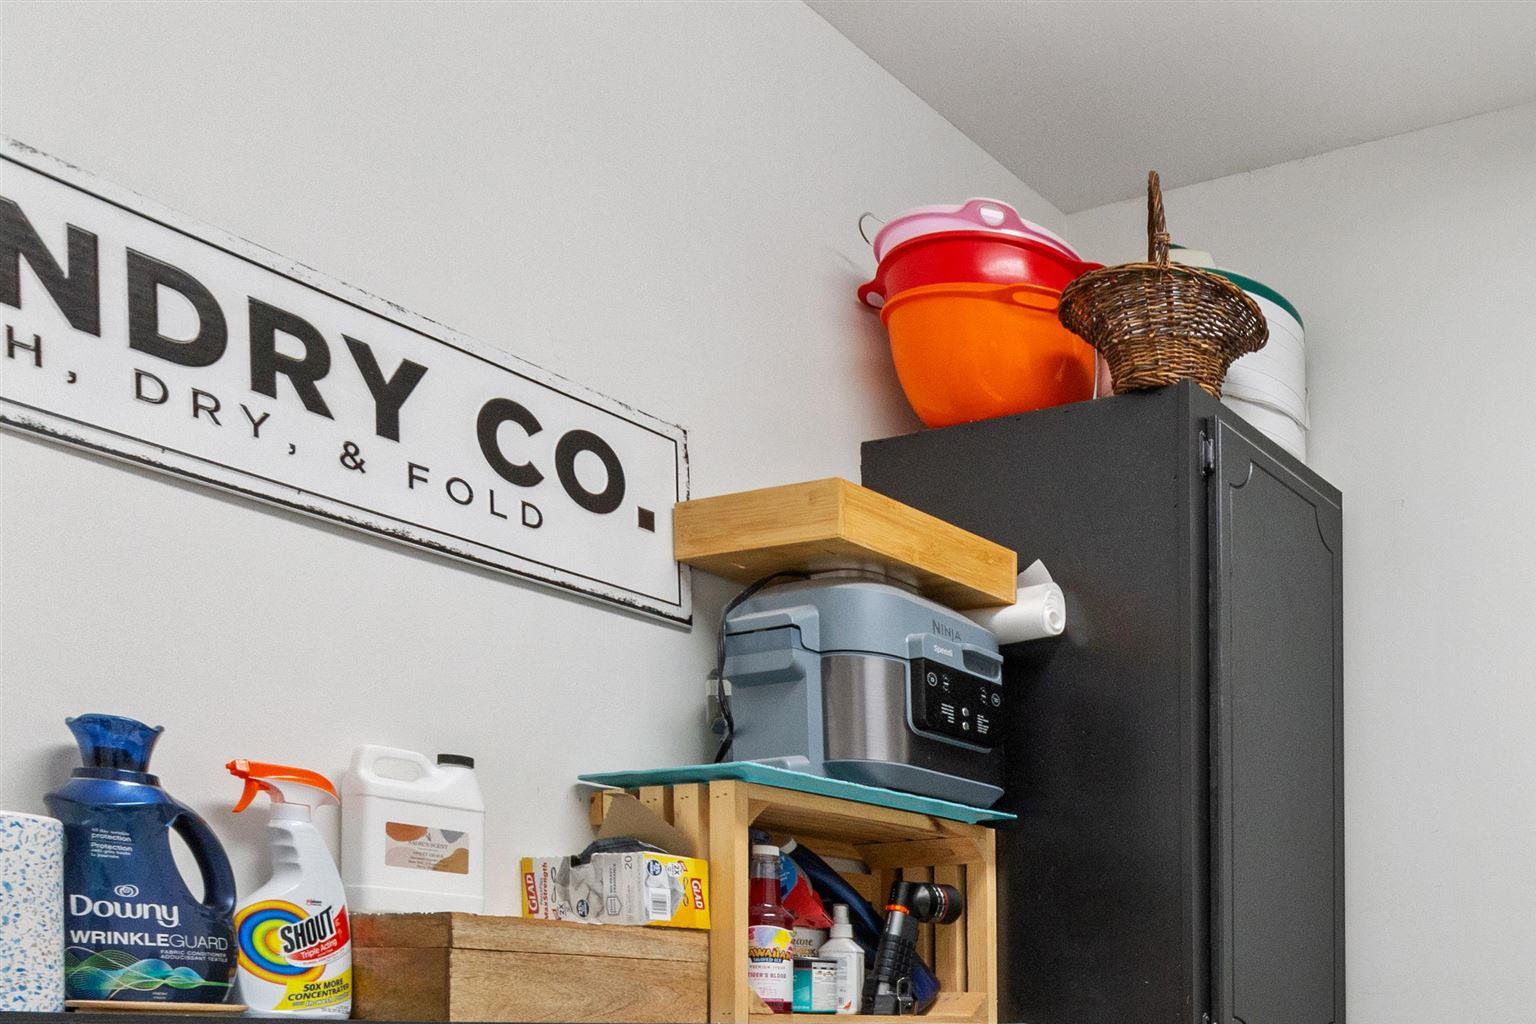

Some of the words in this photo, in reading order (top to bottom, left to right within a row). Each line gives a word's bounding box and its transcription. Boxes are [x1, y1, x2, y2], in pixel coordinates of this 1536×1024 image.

[0, 194, 428, 443] NDRY
[476, 397, 655, 533] CO.
[134, 368, 296, 455] DRY,
[340, 441, 366, 473] &
[408, 462, 543, 529] FOLD
[932, 619, 962, 642] NINJA
[624, 855, 632, 870] 20
[526, 874, 538, 911] GLAD
[692, 880, 703, 908] GLAD
[69, 894, 179, 927] Downy
[69, 930, 228, 950] WRINKLEGUARD
[280, 905, 332, 953] SHOUT
[748, 947, 792, 961] AWAIIAN
[304, 982, 321, 992] 50X
[323, 978, 343, 989] MORE
